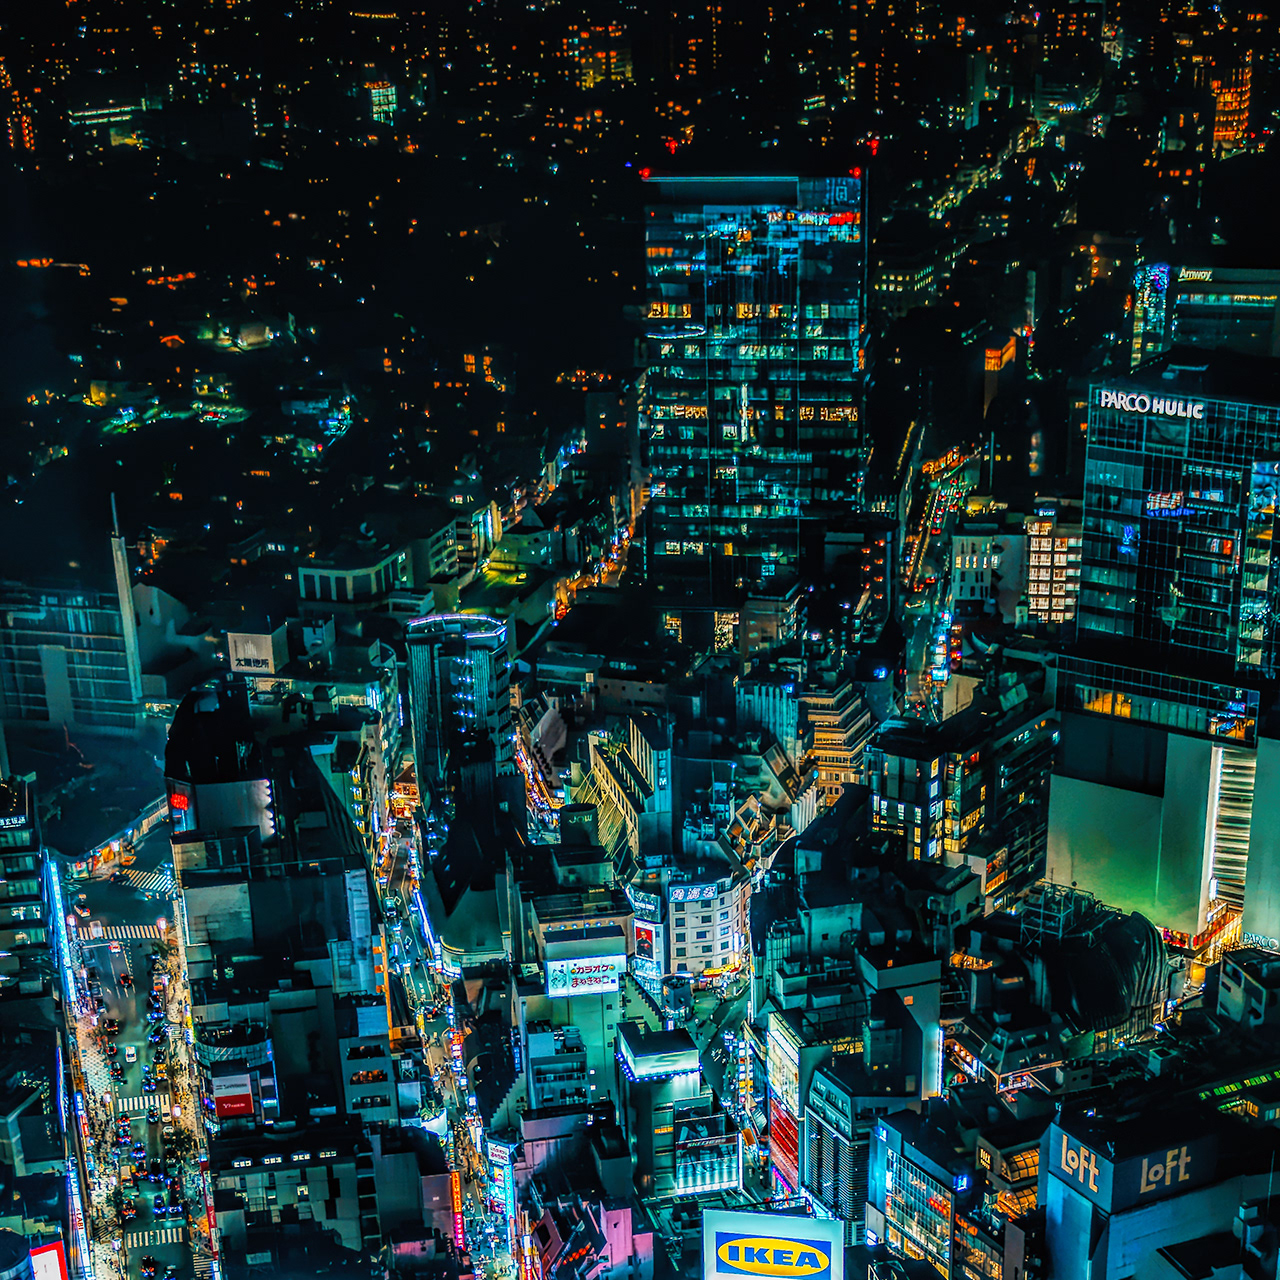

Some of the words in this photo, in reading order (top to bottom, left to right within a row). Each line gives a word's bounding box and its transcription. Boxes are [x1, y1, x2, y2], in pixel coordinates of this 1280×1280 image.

[1100, 390, 1151, 414] PARCO
[1152, 398, 1204, 420] HULIC
[576, 963, 612, 975] カラオケ
[727, 1245, 823, 1270] IKEA
